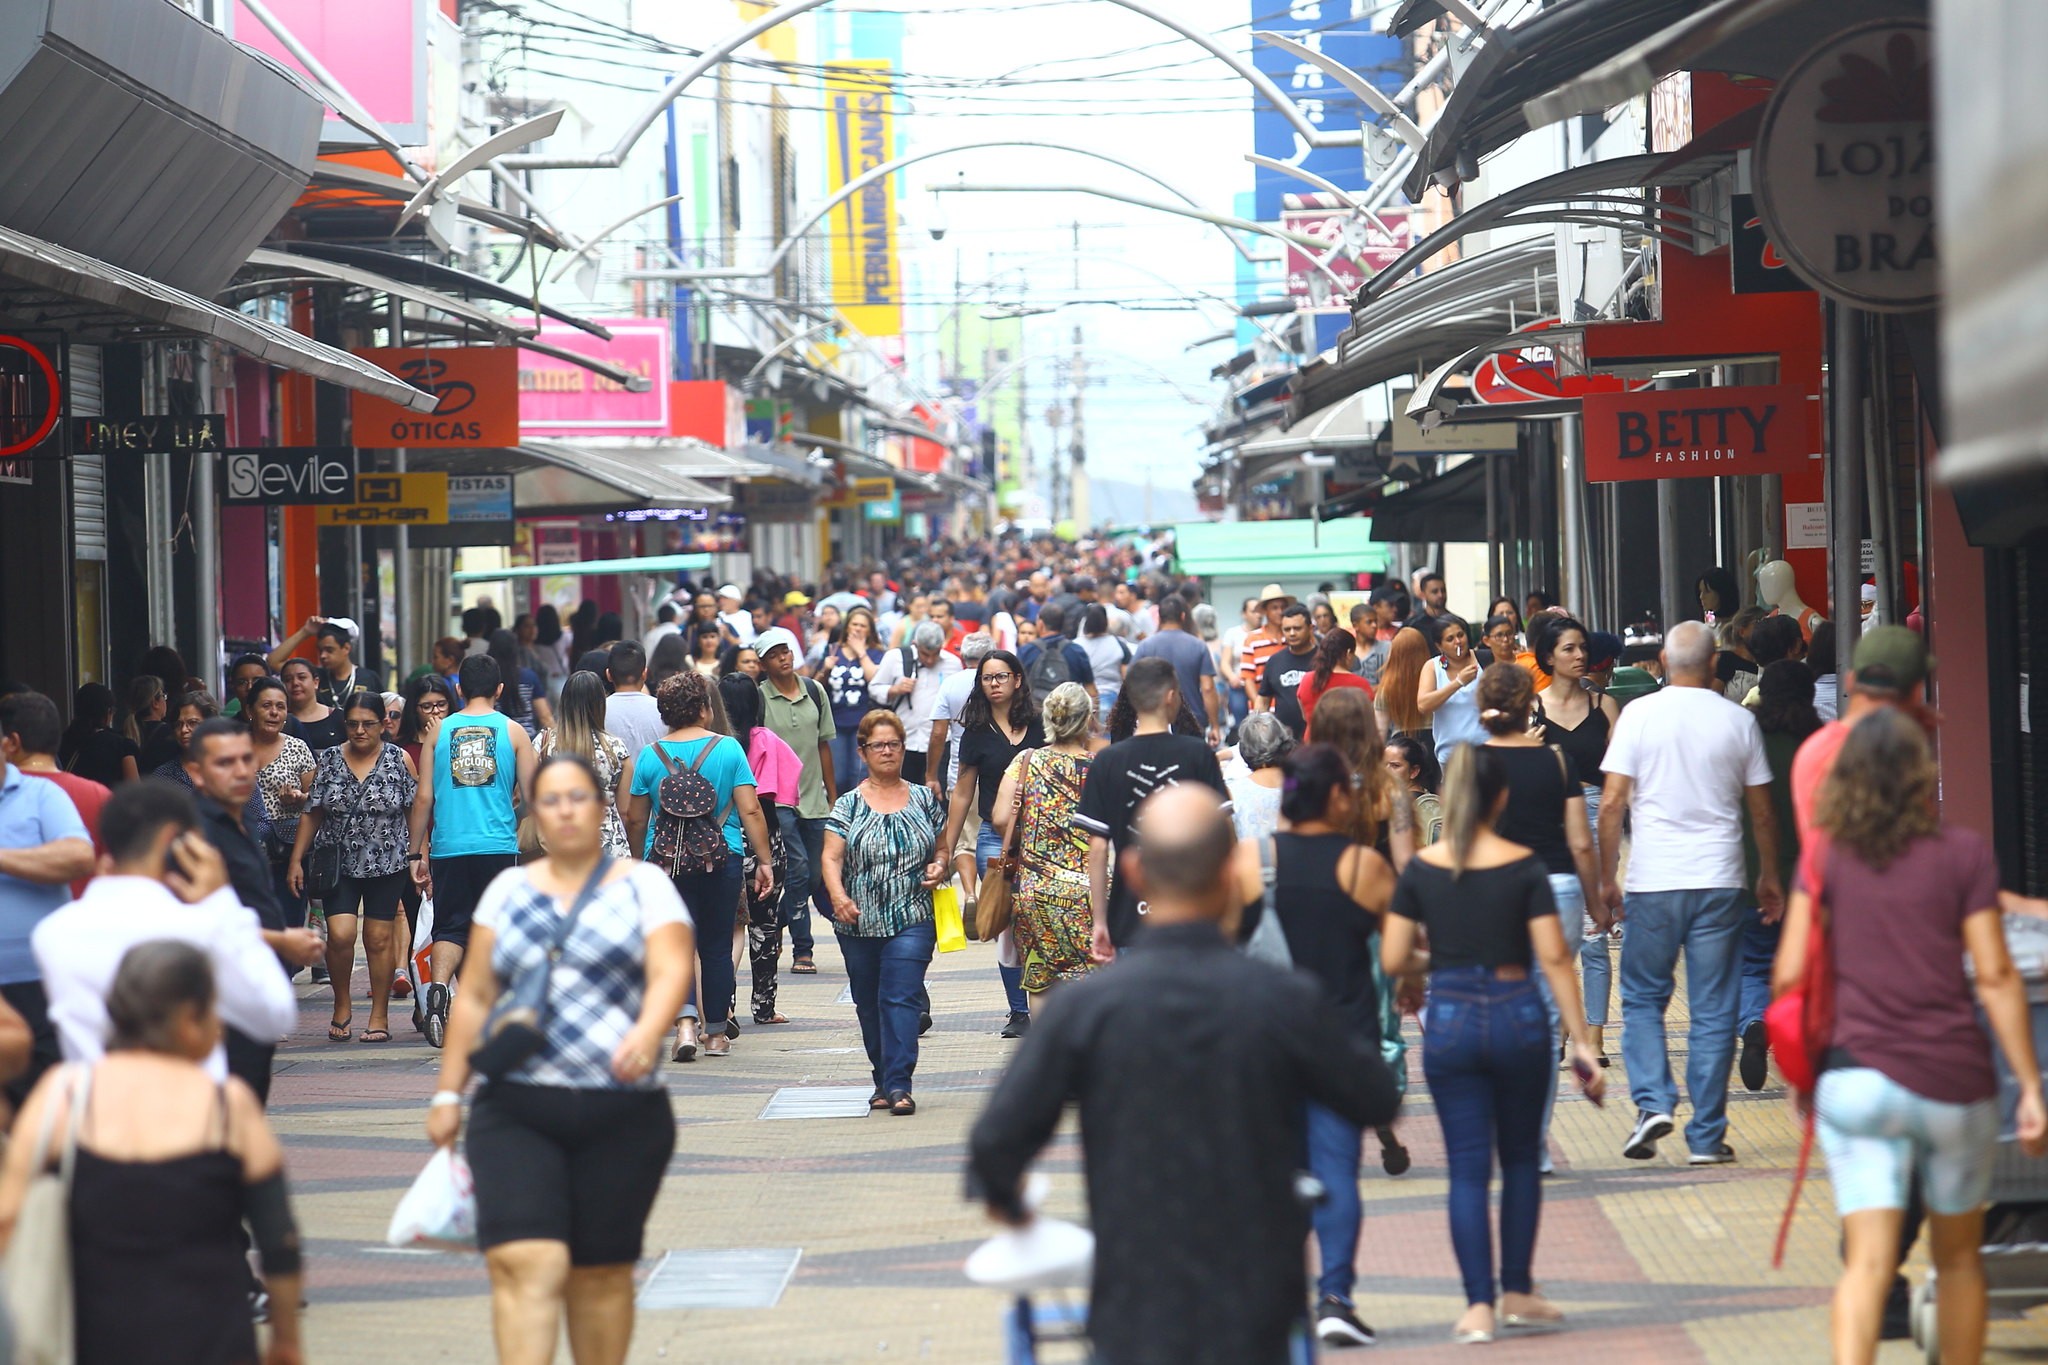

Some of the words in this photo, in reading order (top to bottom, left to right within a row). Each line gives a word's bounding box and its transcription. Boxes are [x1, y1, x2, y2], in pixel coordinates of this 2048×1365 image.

[1616, 405, 1777, 459] BETTY
[1655, 449, 1735, 462] FASHION
[231, 455, 348, 496] Sevile
[453, 757, 493, 770] CYCLONE
